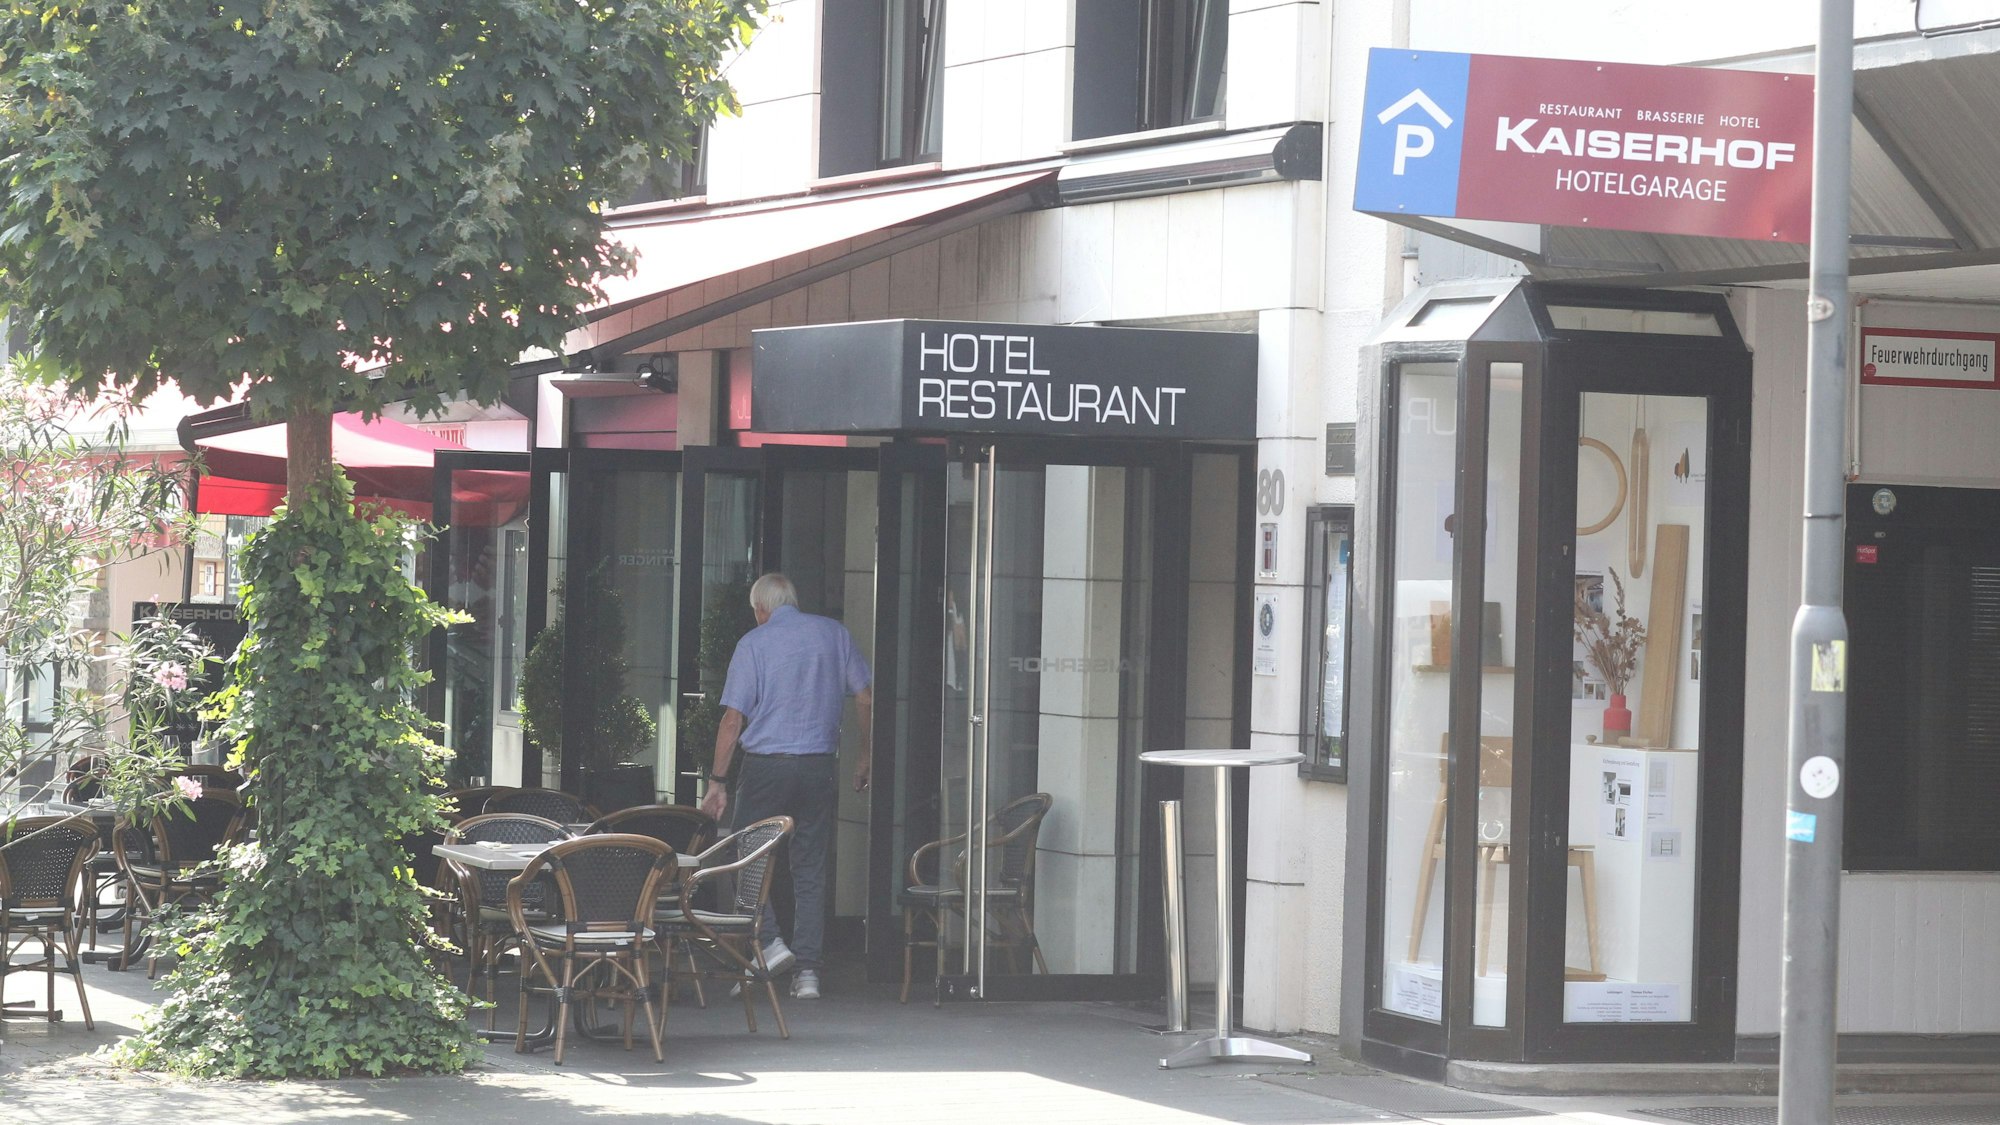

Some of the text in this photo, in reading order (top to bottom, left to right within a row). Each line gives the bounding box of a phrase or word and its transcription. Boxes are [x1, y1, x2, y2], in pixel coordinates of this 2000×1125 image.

[1539, 103, 1761, 129] RESTAURANT BRASSERIE HOTEL
[1392, 123, 1435, 177] P
[1495, 115, 1796, 171] KAISERHOF
[1555, 168, 1728, 202] HOTELGARAGE
[919, 332, 1050, 376] HOTEL
[1871, 344, 1989, 373] Feuerwehrdurchgang
[918, 378, 1187, 426] RESTAURANT
[1257, 468, 1285, 517] 80
[139, 605, 240, 621] KSERHO
